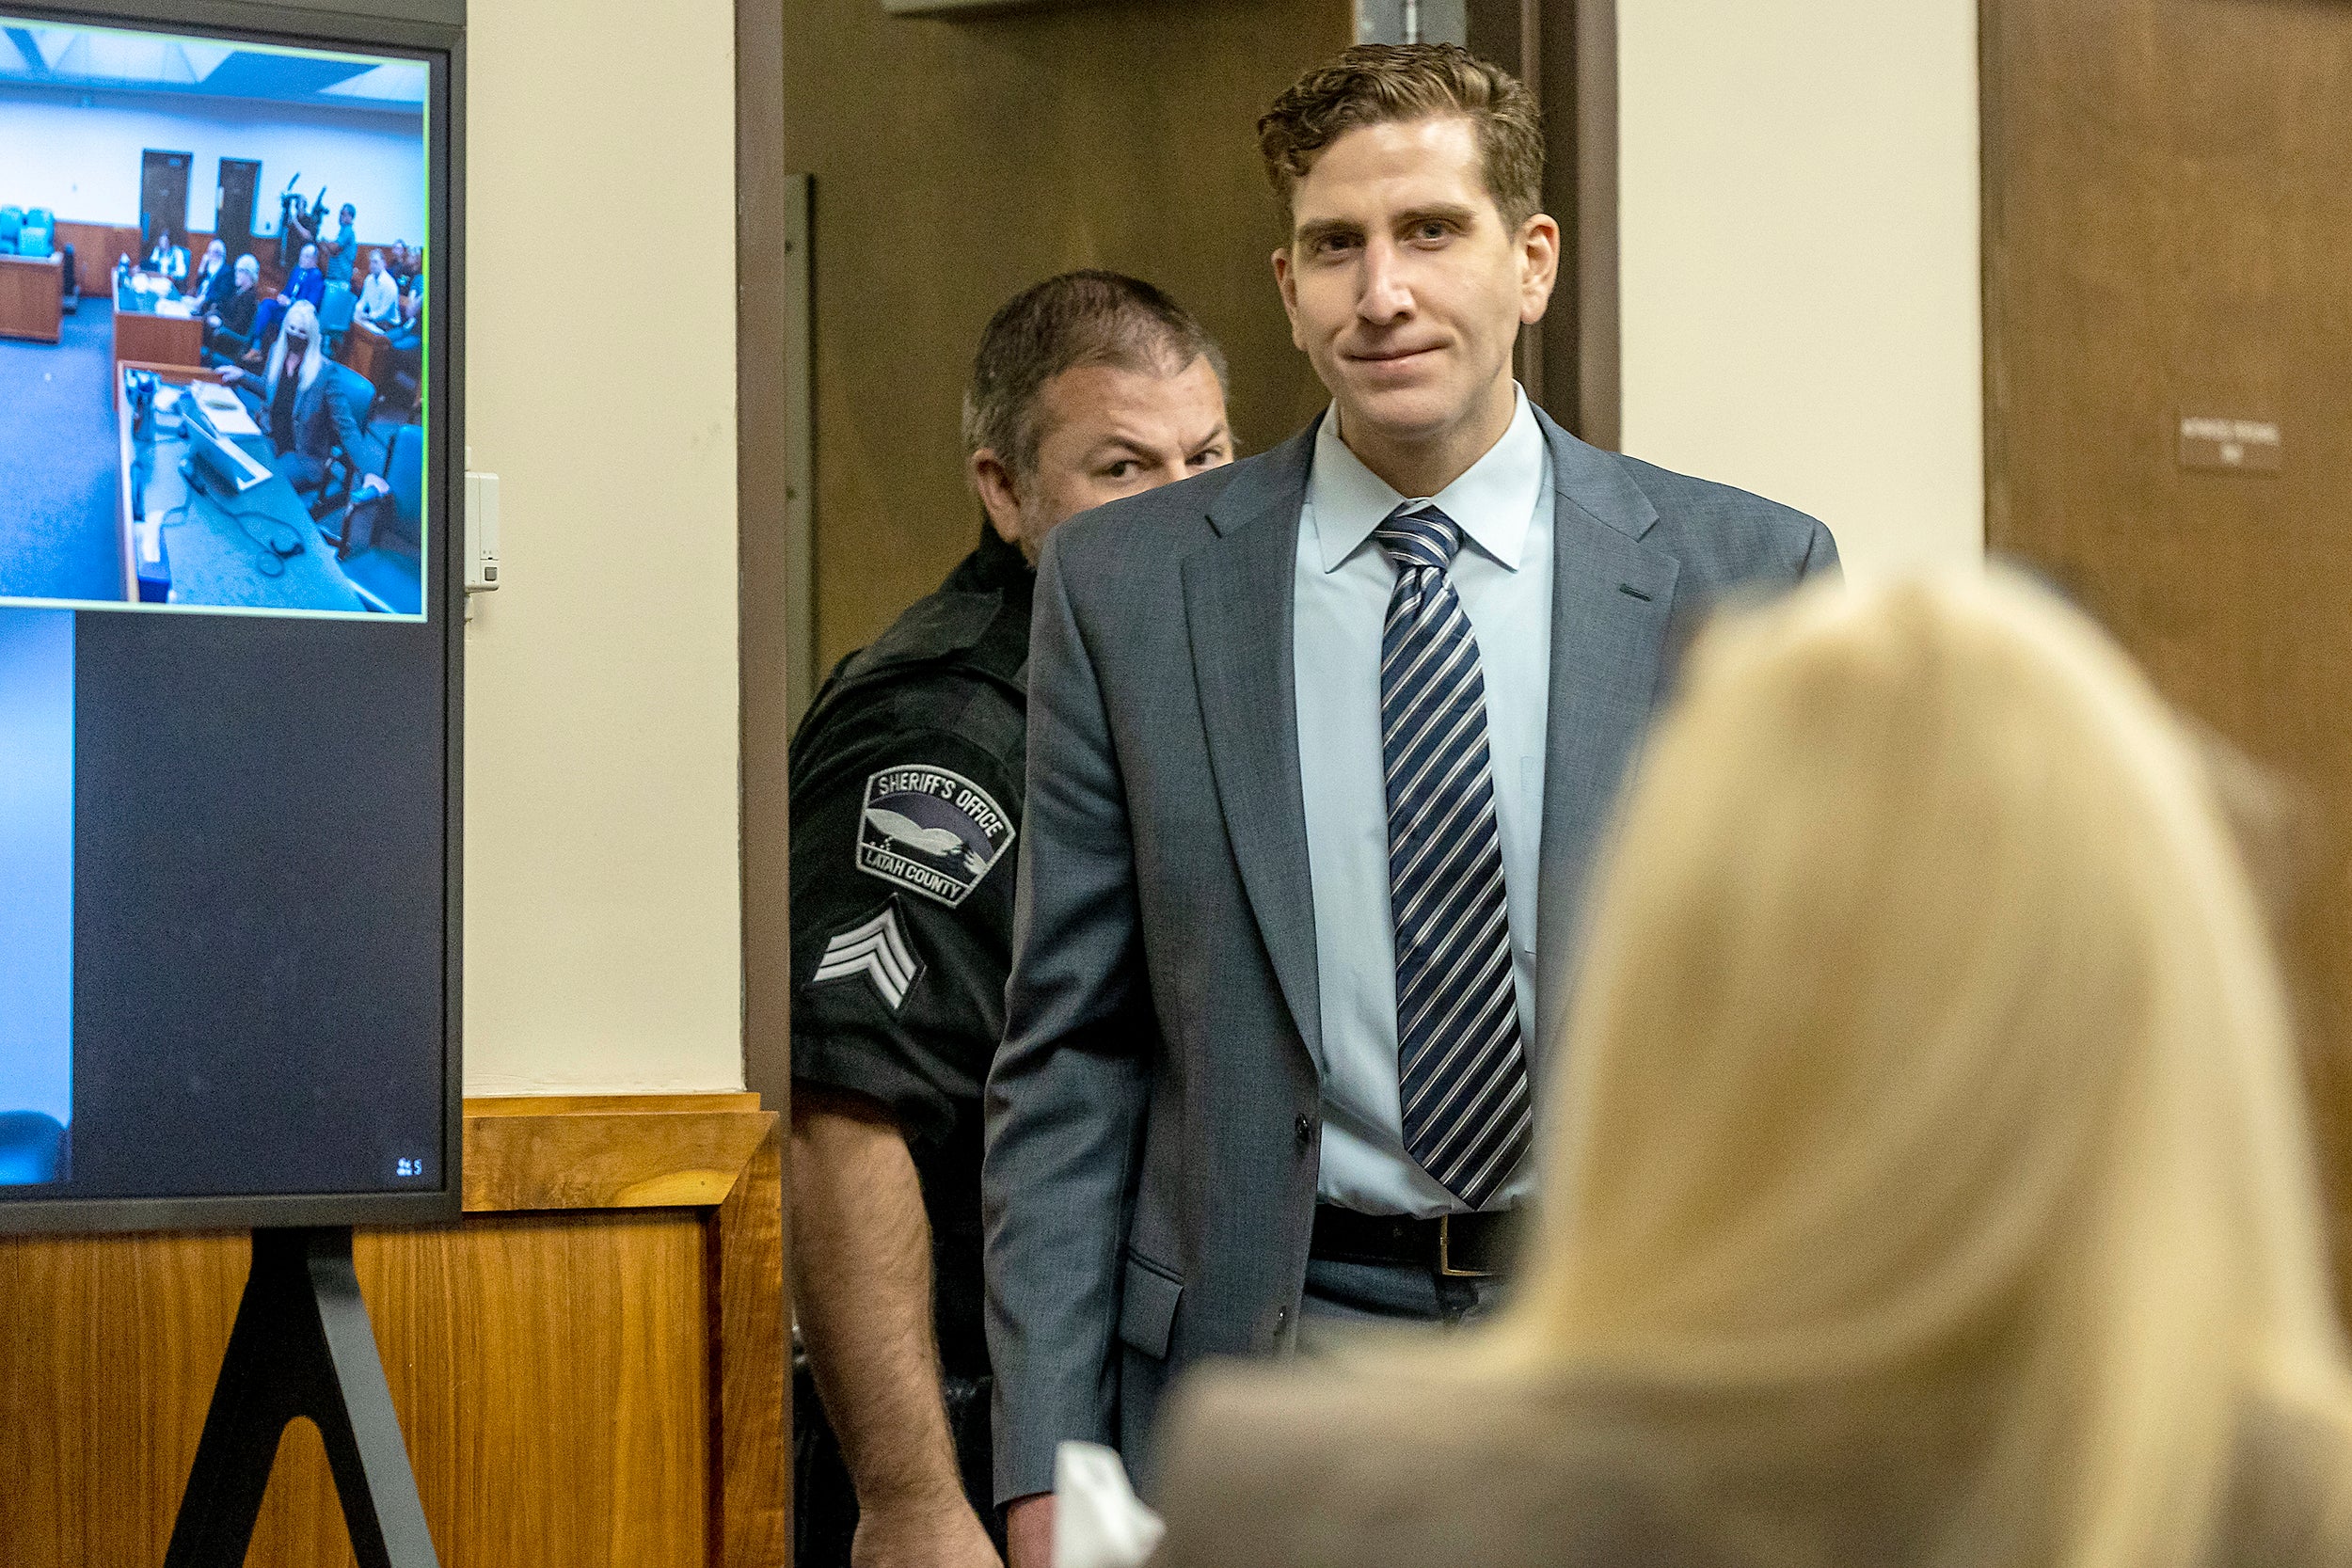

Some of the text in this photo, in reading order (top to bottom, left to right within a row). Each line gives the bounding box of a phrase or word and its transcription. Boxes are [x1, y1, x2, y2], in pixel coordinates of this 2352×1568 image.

[879, 772, 1004, 838] SHERIFF'S OFFICE
[866, 849, 962, 899] LATAH COUNTY
